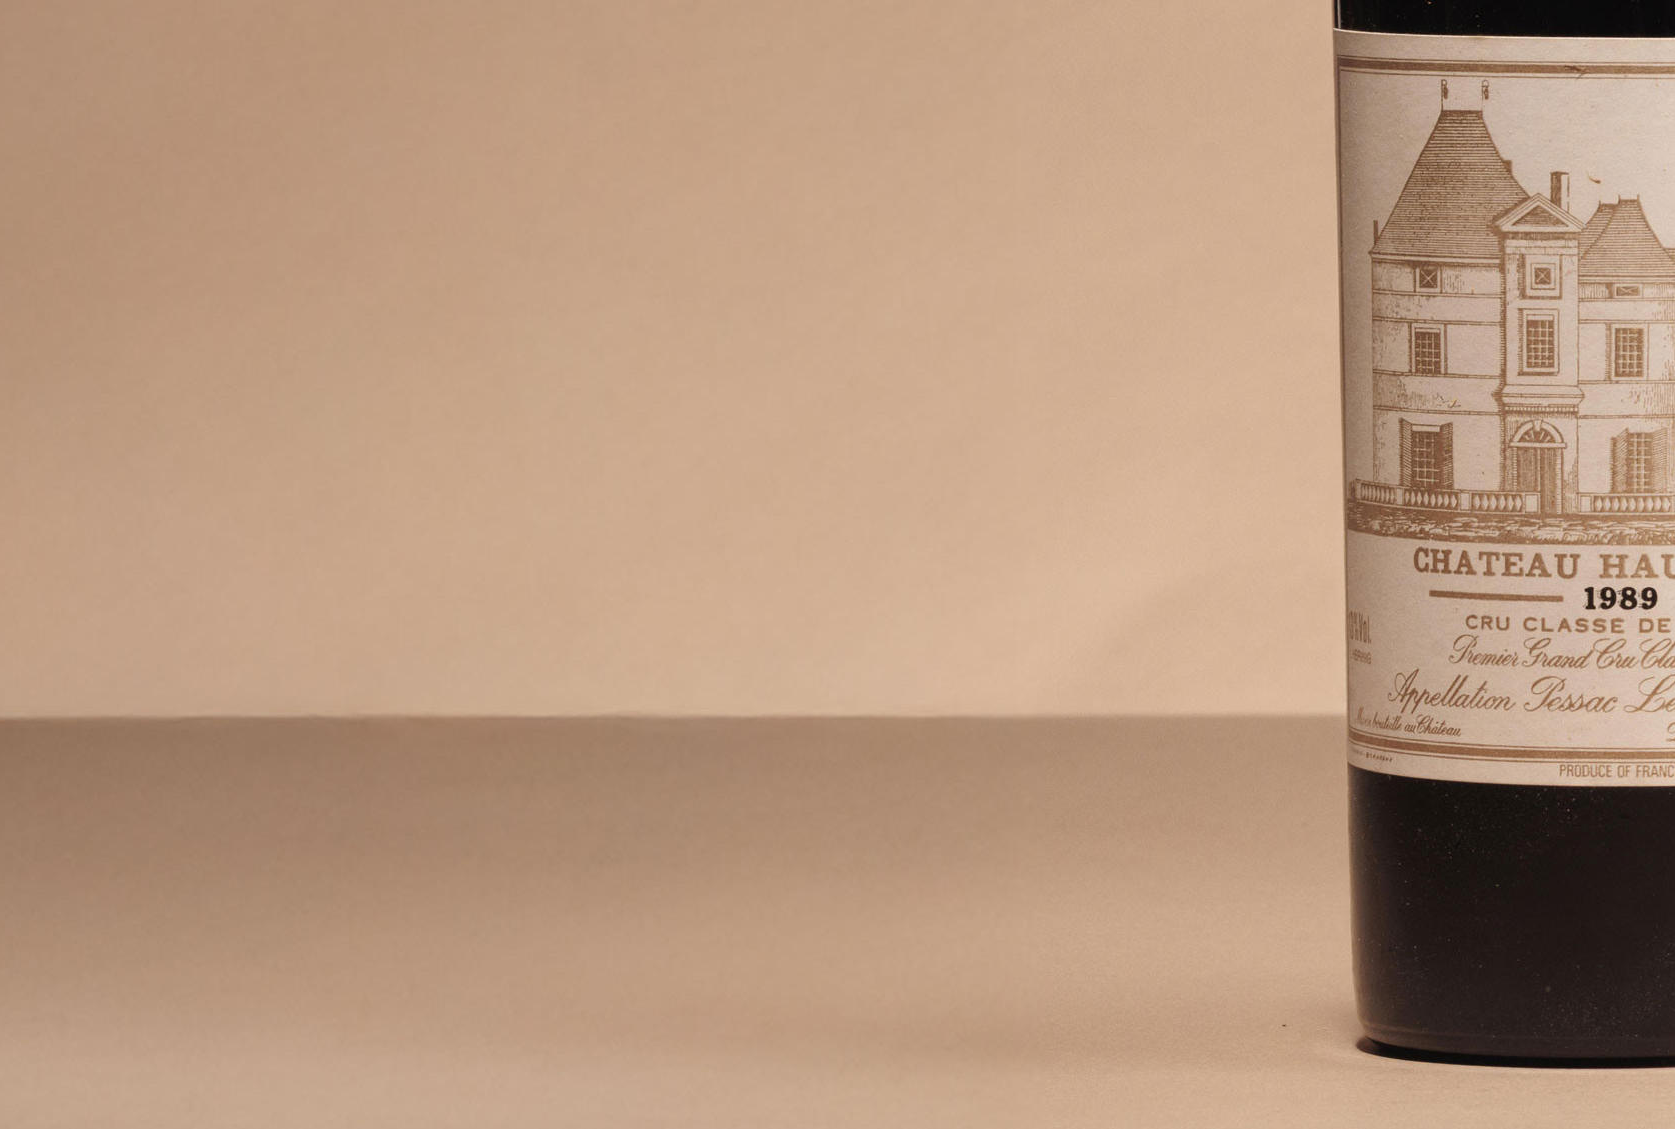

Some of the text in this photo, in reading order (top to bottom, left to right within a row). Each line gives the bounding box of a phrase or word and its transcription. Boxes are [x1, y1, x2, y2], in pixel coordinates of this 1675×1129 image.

[1413, 547, 1581, 579] CHATEAU
[1583, 586, 1658, 610] 1989
[1465, 614, 1510, 631] CRU
[1523, 617, 1625, 634] CLASSE
[1638, 618, 1671, 634] DE
[1448, 634, 1519, 668] Premier
[1522, 637, 1590, 669] Grand
[1592, 638, 1637, 670] Cru
[1387, 668, 1517, 714] Appellation
[1523, 675, 1618, 713] Pessac
[1559, 765, 1613, 779] PRODUCE
[1617, 765, 1631, 779] OF
